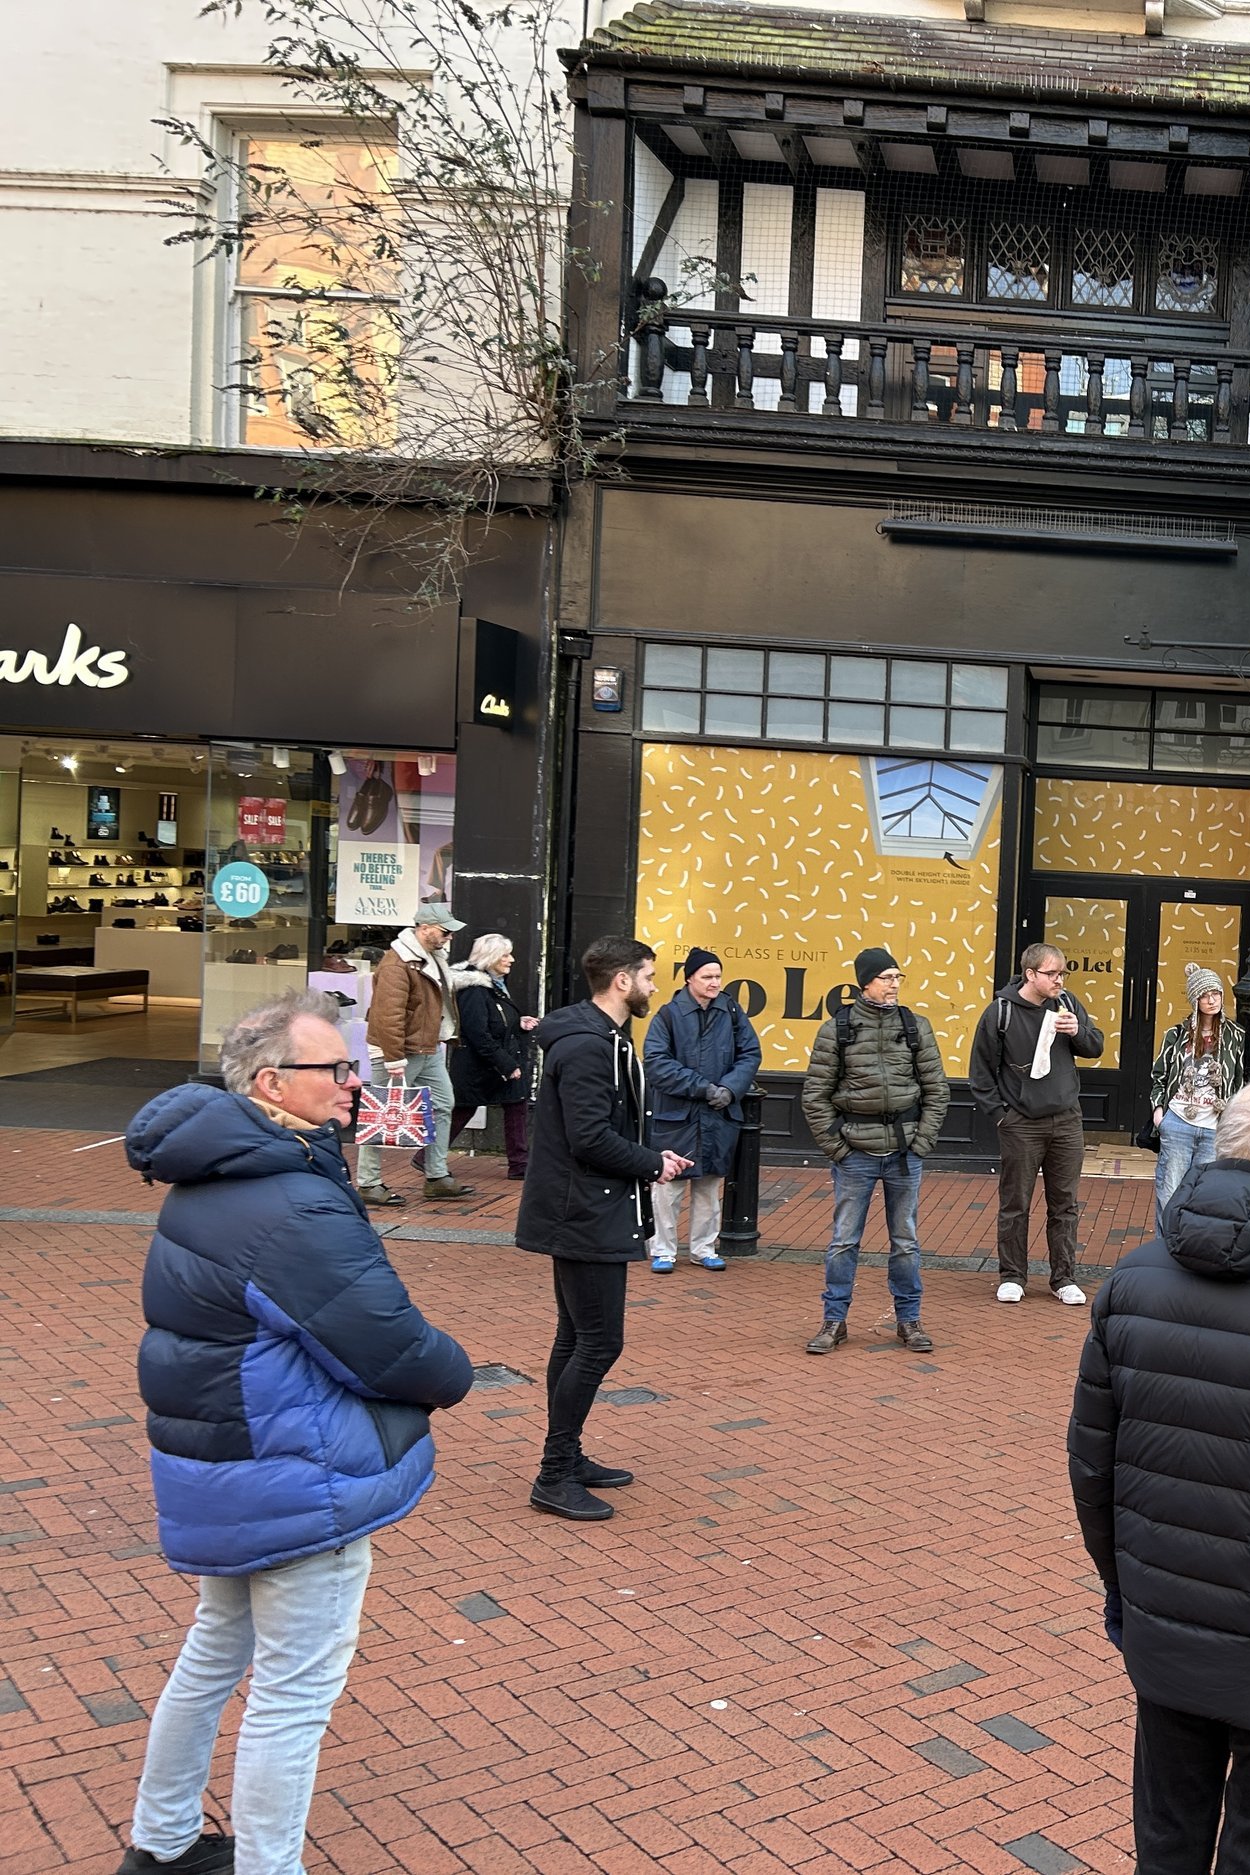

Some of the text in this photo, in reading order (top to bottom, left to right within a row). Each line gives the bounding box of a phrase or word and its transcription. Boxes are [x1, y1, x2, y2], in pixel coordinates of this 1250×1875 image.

[0, 623, 129, 689] arks
[243, 814, 259, 825] SALE
[268, 815, 282, 826] SALE
[360, 852, 397, 864] THERE'S
[353, 863, 403, 874] NO BETTER
[360, 874, 396, 885] FEELING
[220, 882, 261, 904] £60
[355, 897, 396, 908] A NEW
[354, 908, 399, 917] SEASON
[674, 944, 829, 962] PRE CLASS E UNIT
[1064, 956, 1113, 973] o Let
[781, 967, 862, 1020] Le
